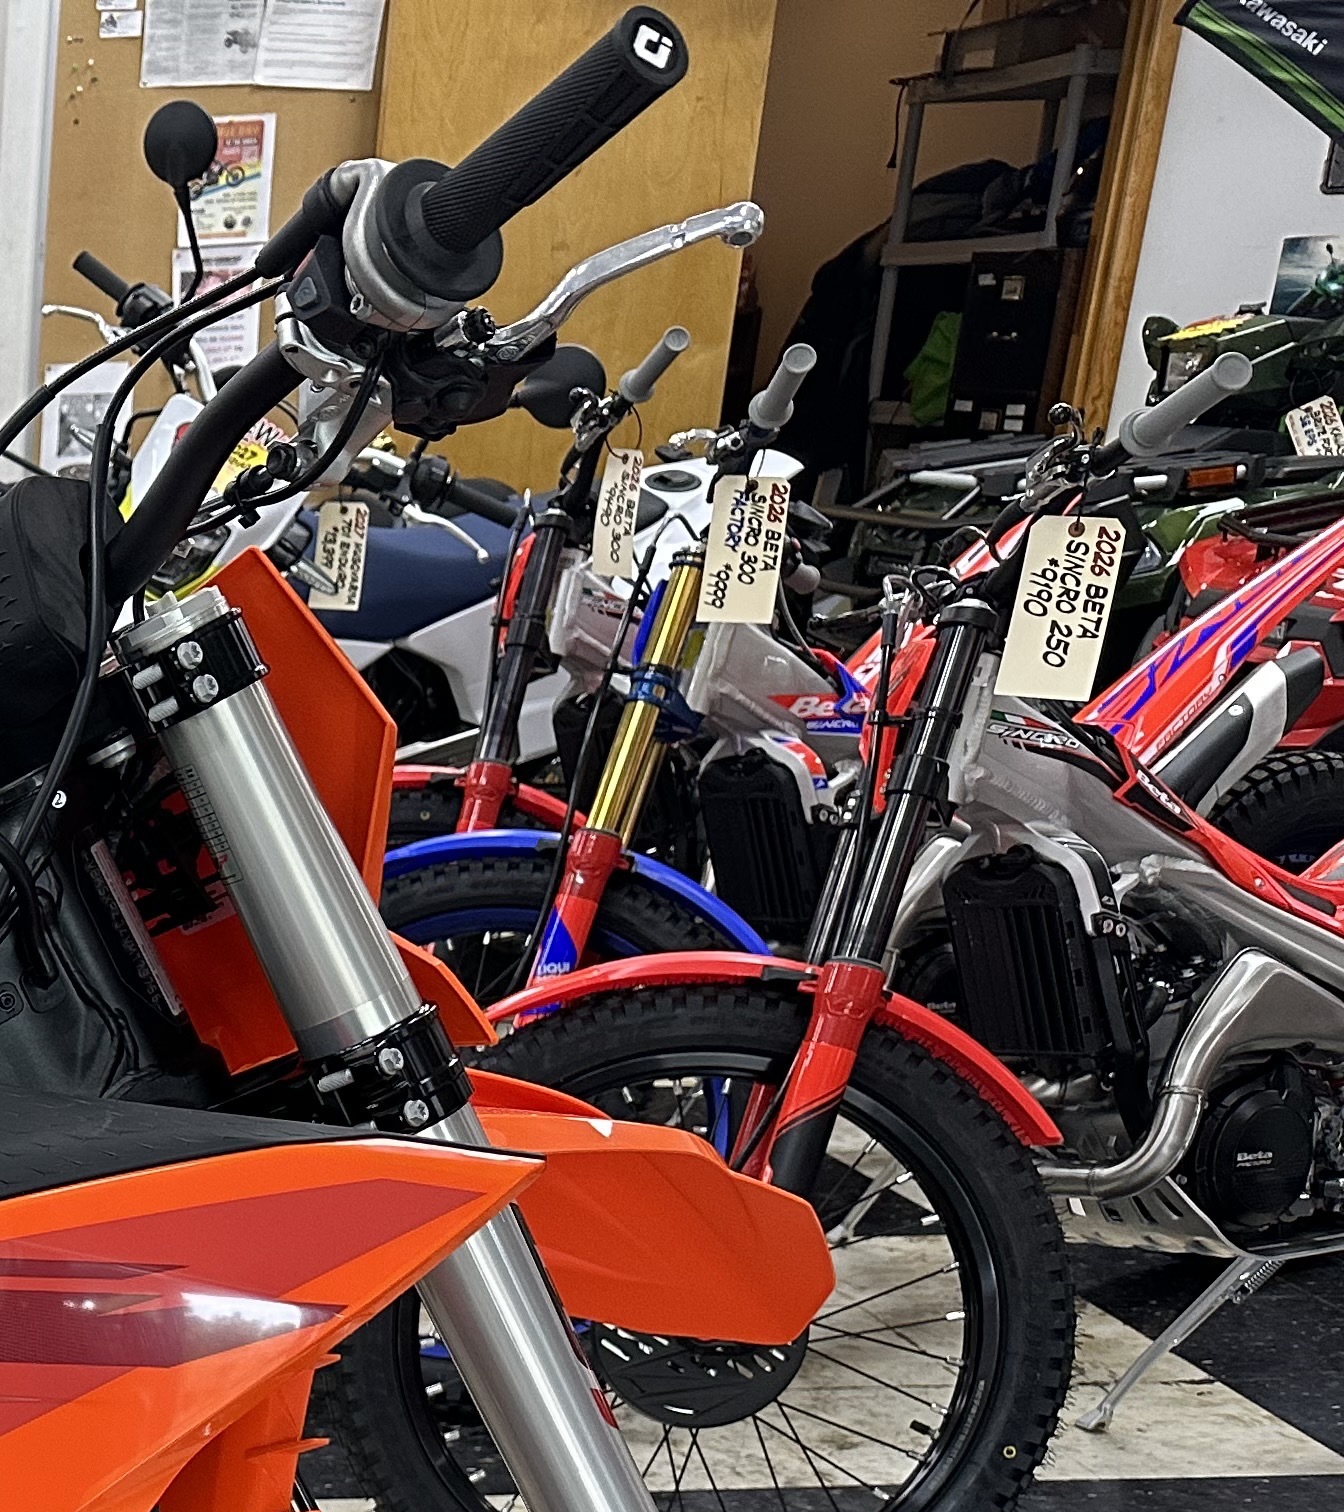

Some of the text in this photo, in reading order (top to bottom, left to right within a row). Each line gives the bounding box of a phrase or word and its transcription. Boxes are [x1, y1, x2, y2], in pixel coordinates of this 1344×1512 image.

[1240, 0, 1328, 56] awasaki
[622, 455, 642, 537] 2026 BETA
[724, 489, 747, 553] FACTORY
[759, 482, 789, 571] 2026 BETA
[610, 528, 622, 563] 300
[737, 492, 767, 585] SINCRO 300
[1042, 539, 1089, 668] SINCRO 250
[1076, 526, 1121, 639] 2026 BETA
[1136, 769, 1181, 815] Beta
